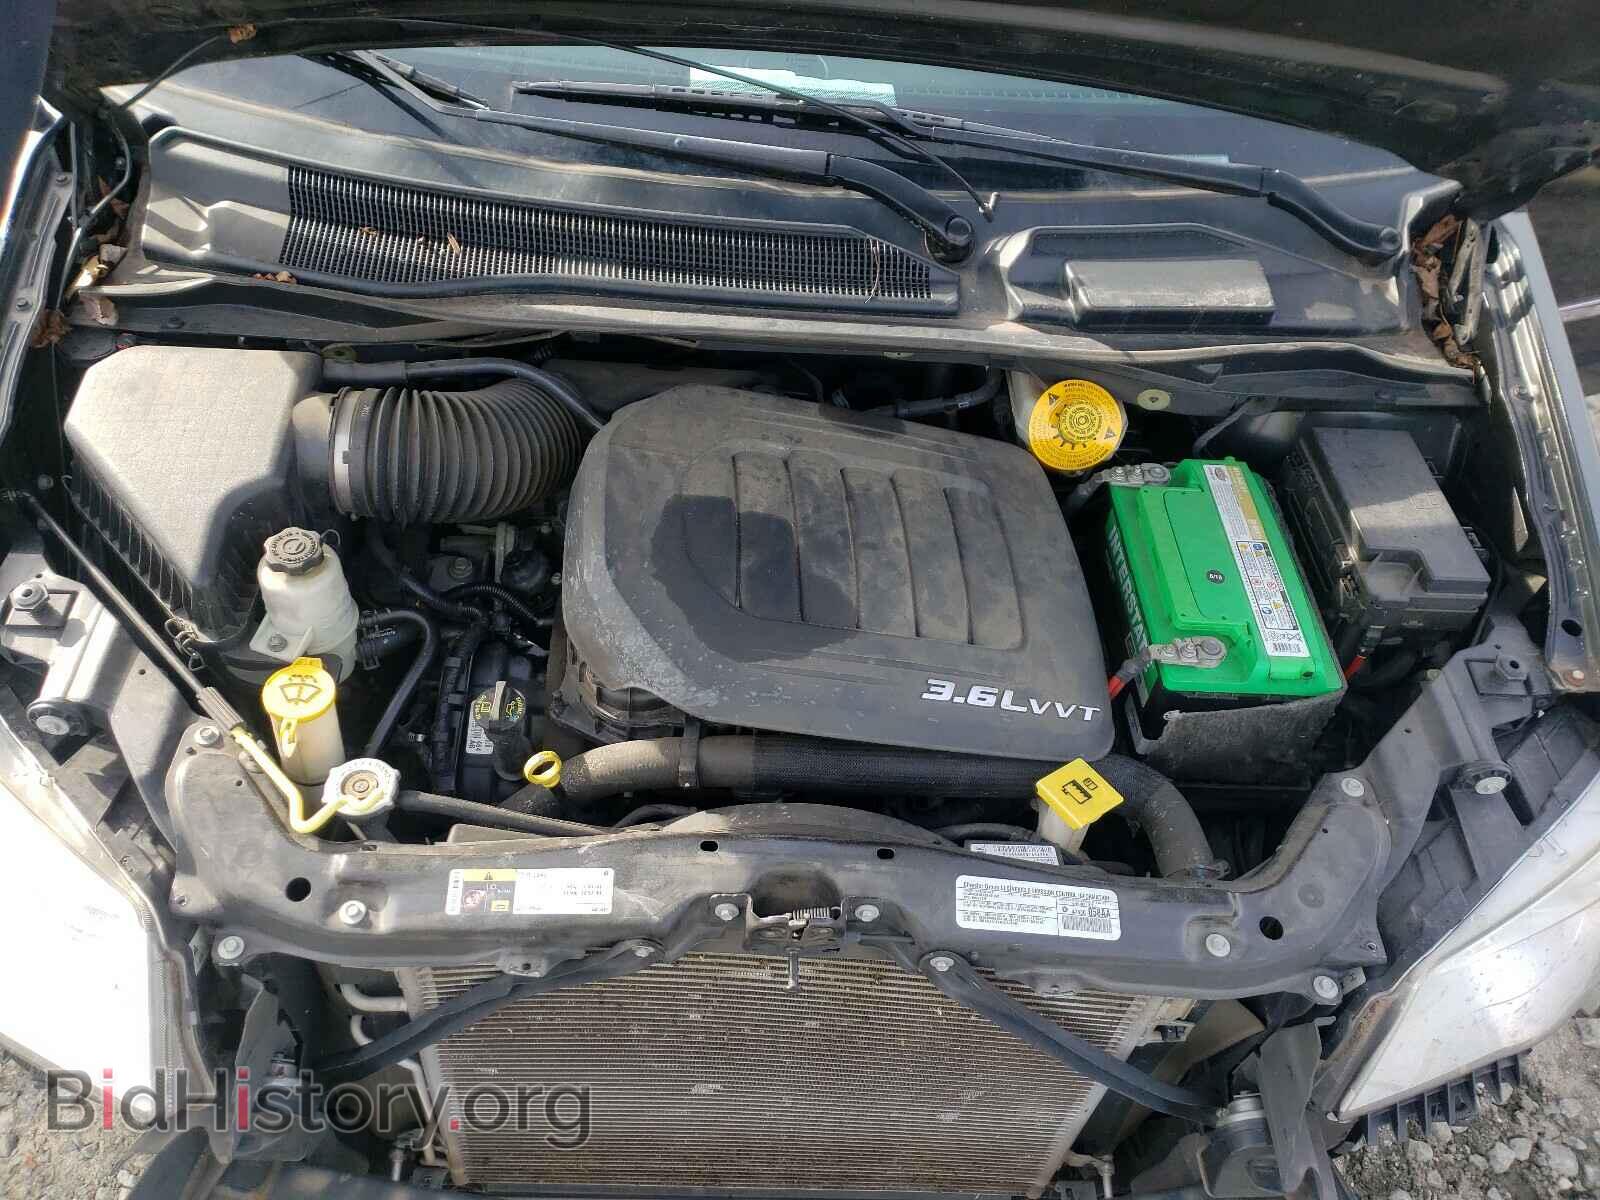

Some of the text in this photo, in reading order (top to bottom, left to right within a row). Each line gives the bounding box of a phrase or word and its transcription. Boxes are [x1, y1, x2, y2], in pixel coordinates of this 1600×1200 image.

[1108, 524, 1153, 671] INTERSTAT
[921, 678, 1101, 721] 3.6L VVT
